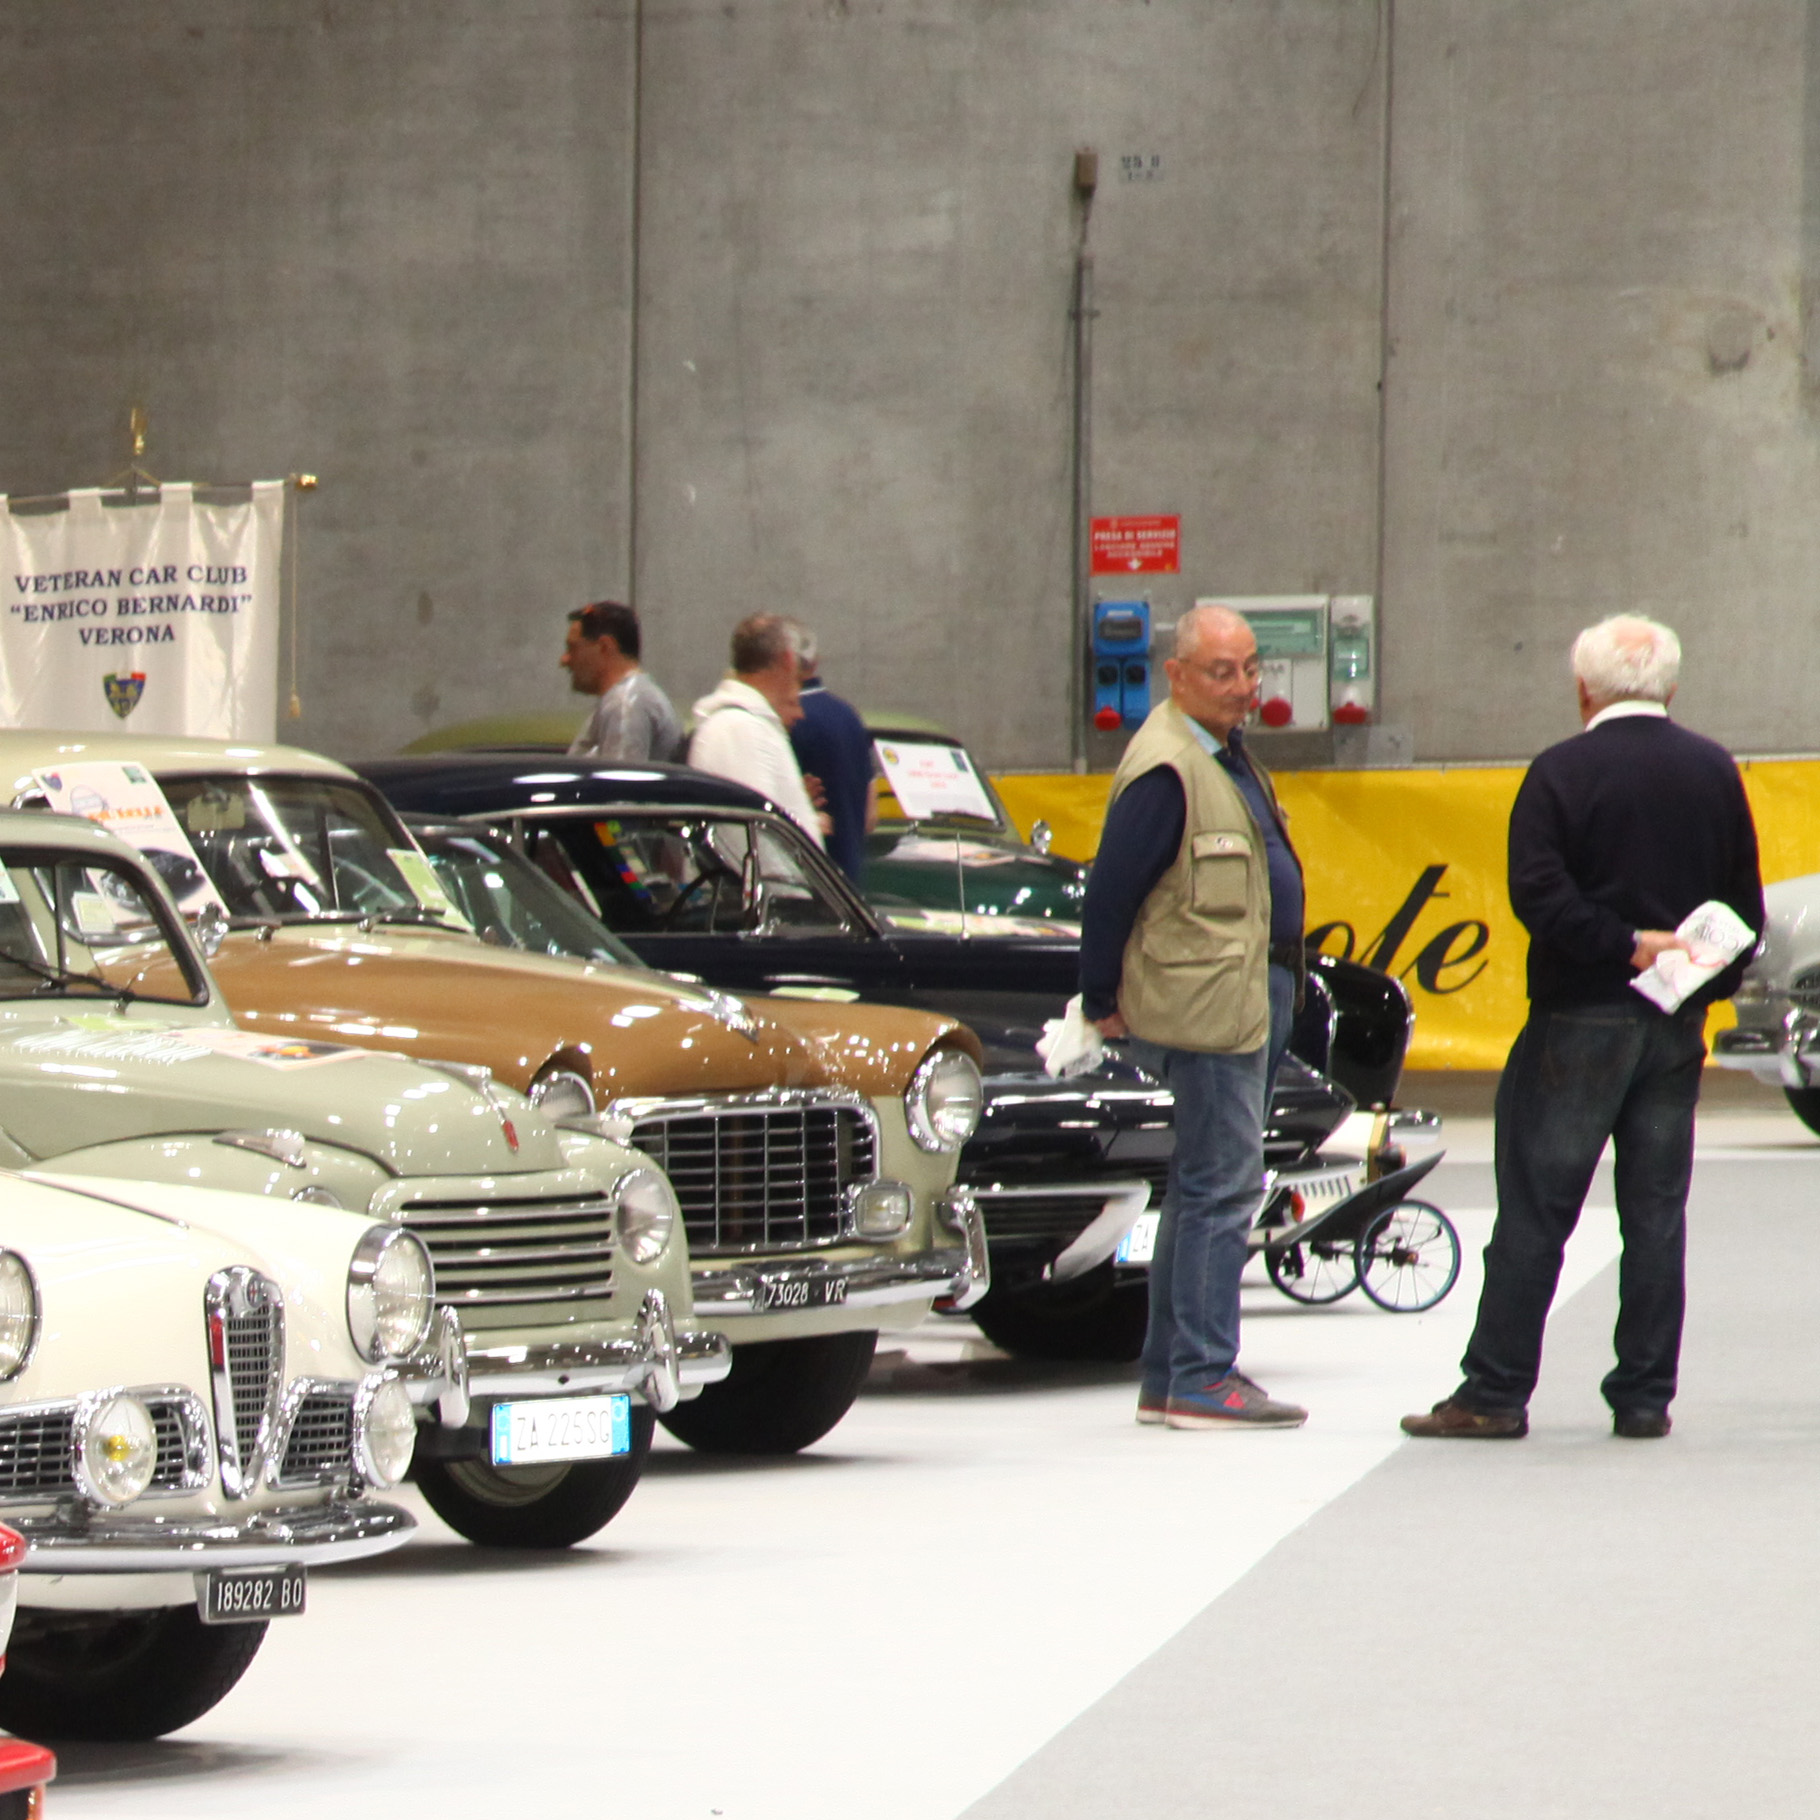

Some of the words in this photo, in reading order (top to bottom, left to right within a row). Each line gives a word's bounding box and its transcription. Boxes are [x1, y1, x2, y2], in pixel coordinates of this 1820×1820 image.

[14, 569, 123, 594] VETERAN
[128, 564, 178, 587] CAR
[186, 564, 249, 585] CLUB
[78, 623, 177, 647] VERONA
[824, 1278, 846, 1304] VR
[516, 1416, 539, 1452] ZA
[547, 1410, 610, 1447] 225SG
[216, 1579, 274, 1613] 189282
[280, 1577, 303, 1609] BO
